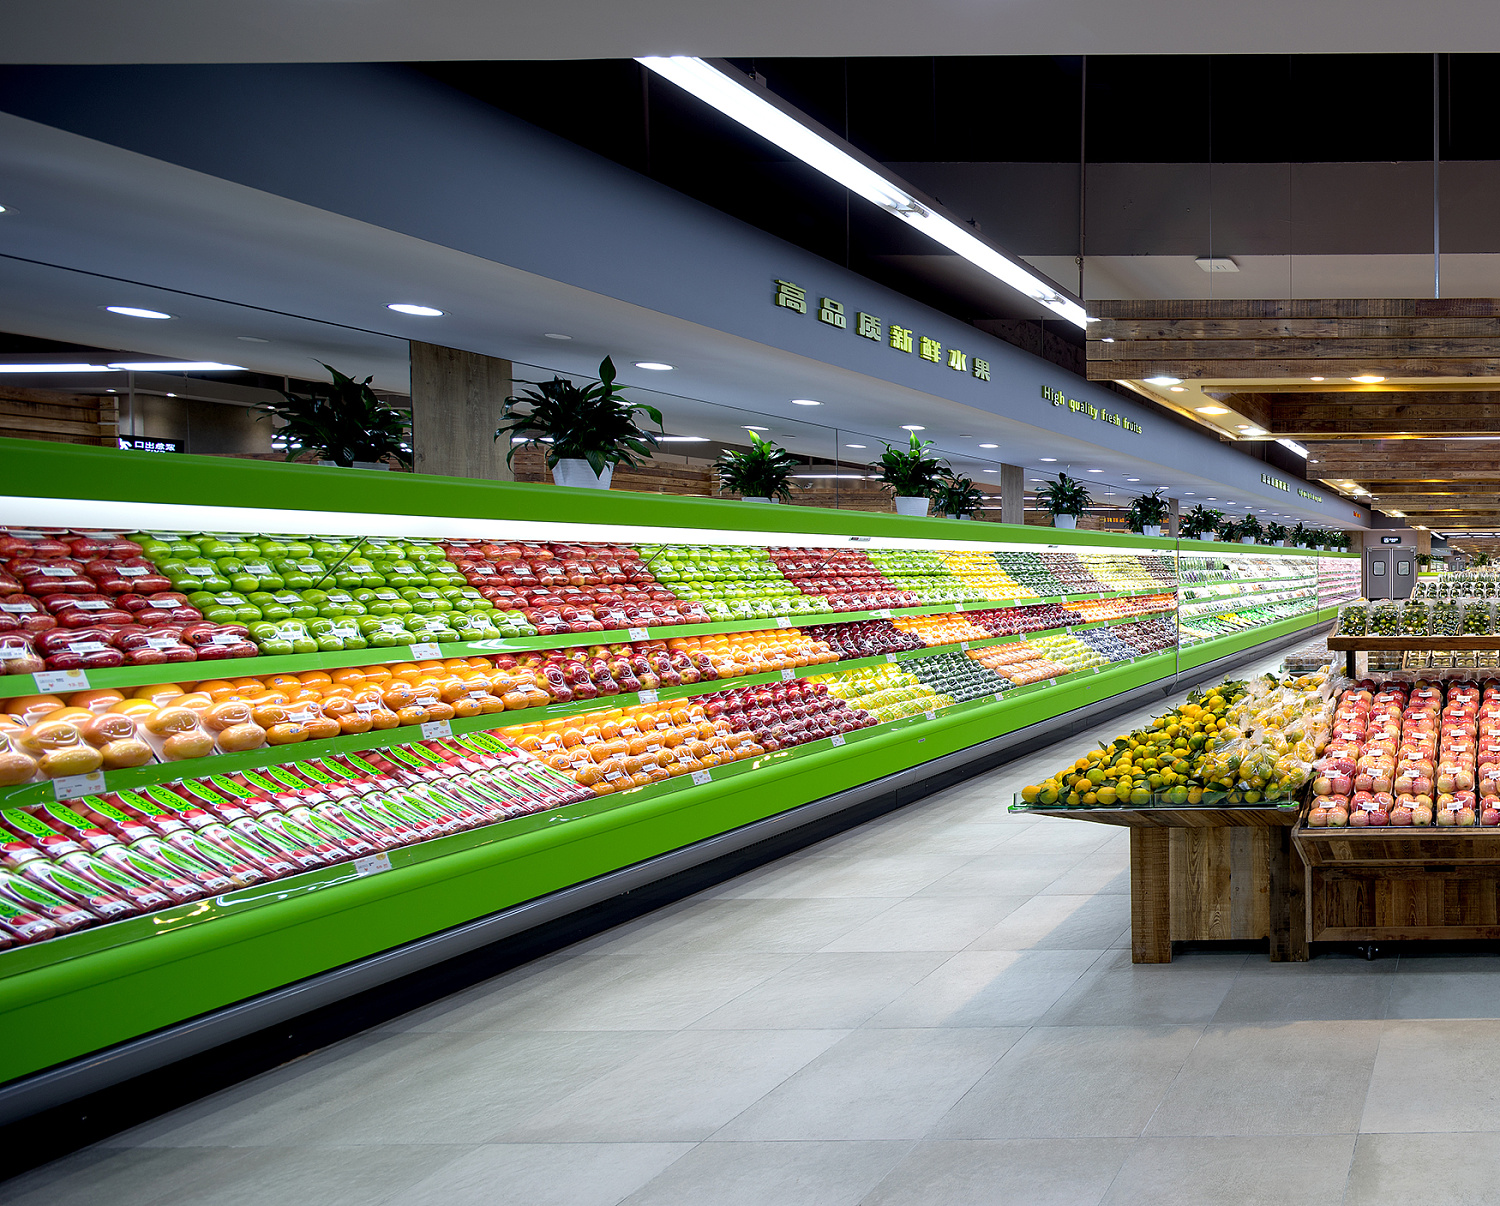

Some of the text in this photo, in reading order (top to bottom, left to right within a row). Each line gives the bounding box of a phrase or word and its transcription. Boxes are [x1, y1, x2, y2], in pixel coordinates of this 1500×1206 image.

[774, 279, 991, 382] 高品质新鲜水果
[1041, 385, 1142, 434] High quality fresh fruits
[121, 791, 156, 814] ROCKIT
[153, 786, 185, 807] ROCKIT
[186, 780, 219, 802] ROCKIT
[50, 803, 84, 826] ROCKIT
[88, 797, 123, 820] ROCKIT
[8, 810, 45, 832] ROCKIT
